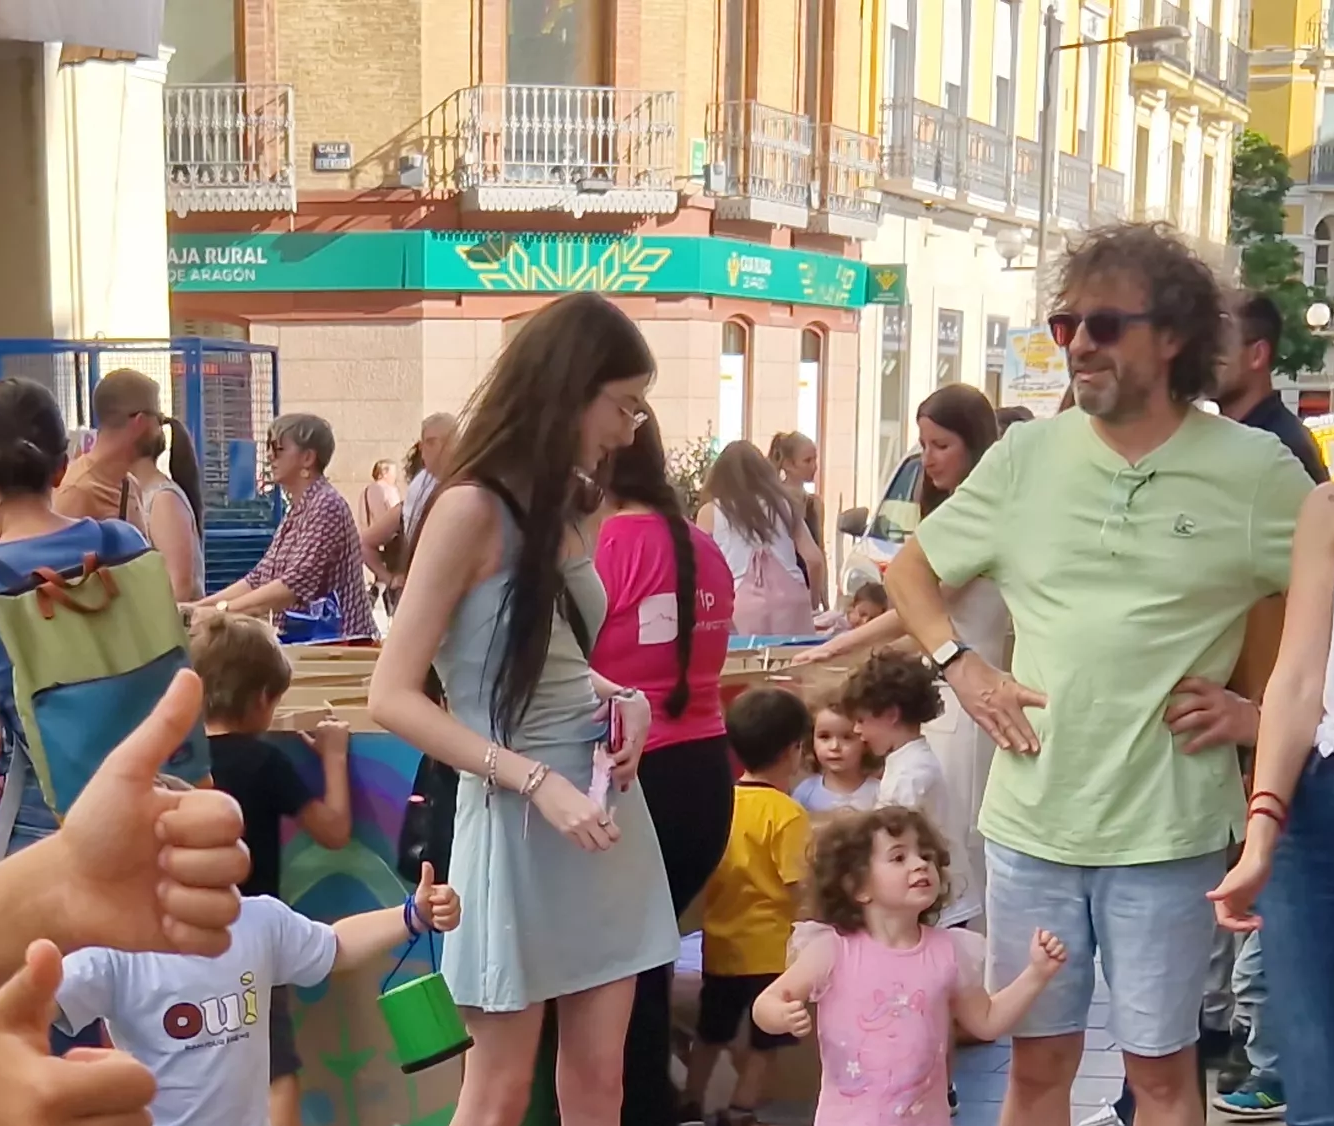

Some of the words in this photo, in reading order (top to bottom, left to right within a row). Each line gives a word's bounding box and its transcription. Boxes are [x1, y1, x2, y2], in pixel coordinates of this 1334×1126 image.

[167, 247, 201, 264] AJA
[205, 246, 268, 265] RURAL
[167, 269, 186, 282] DE
[190, 266, 257, 282] ARAGÓN
[163, 971, 258, 1040] oui
